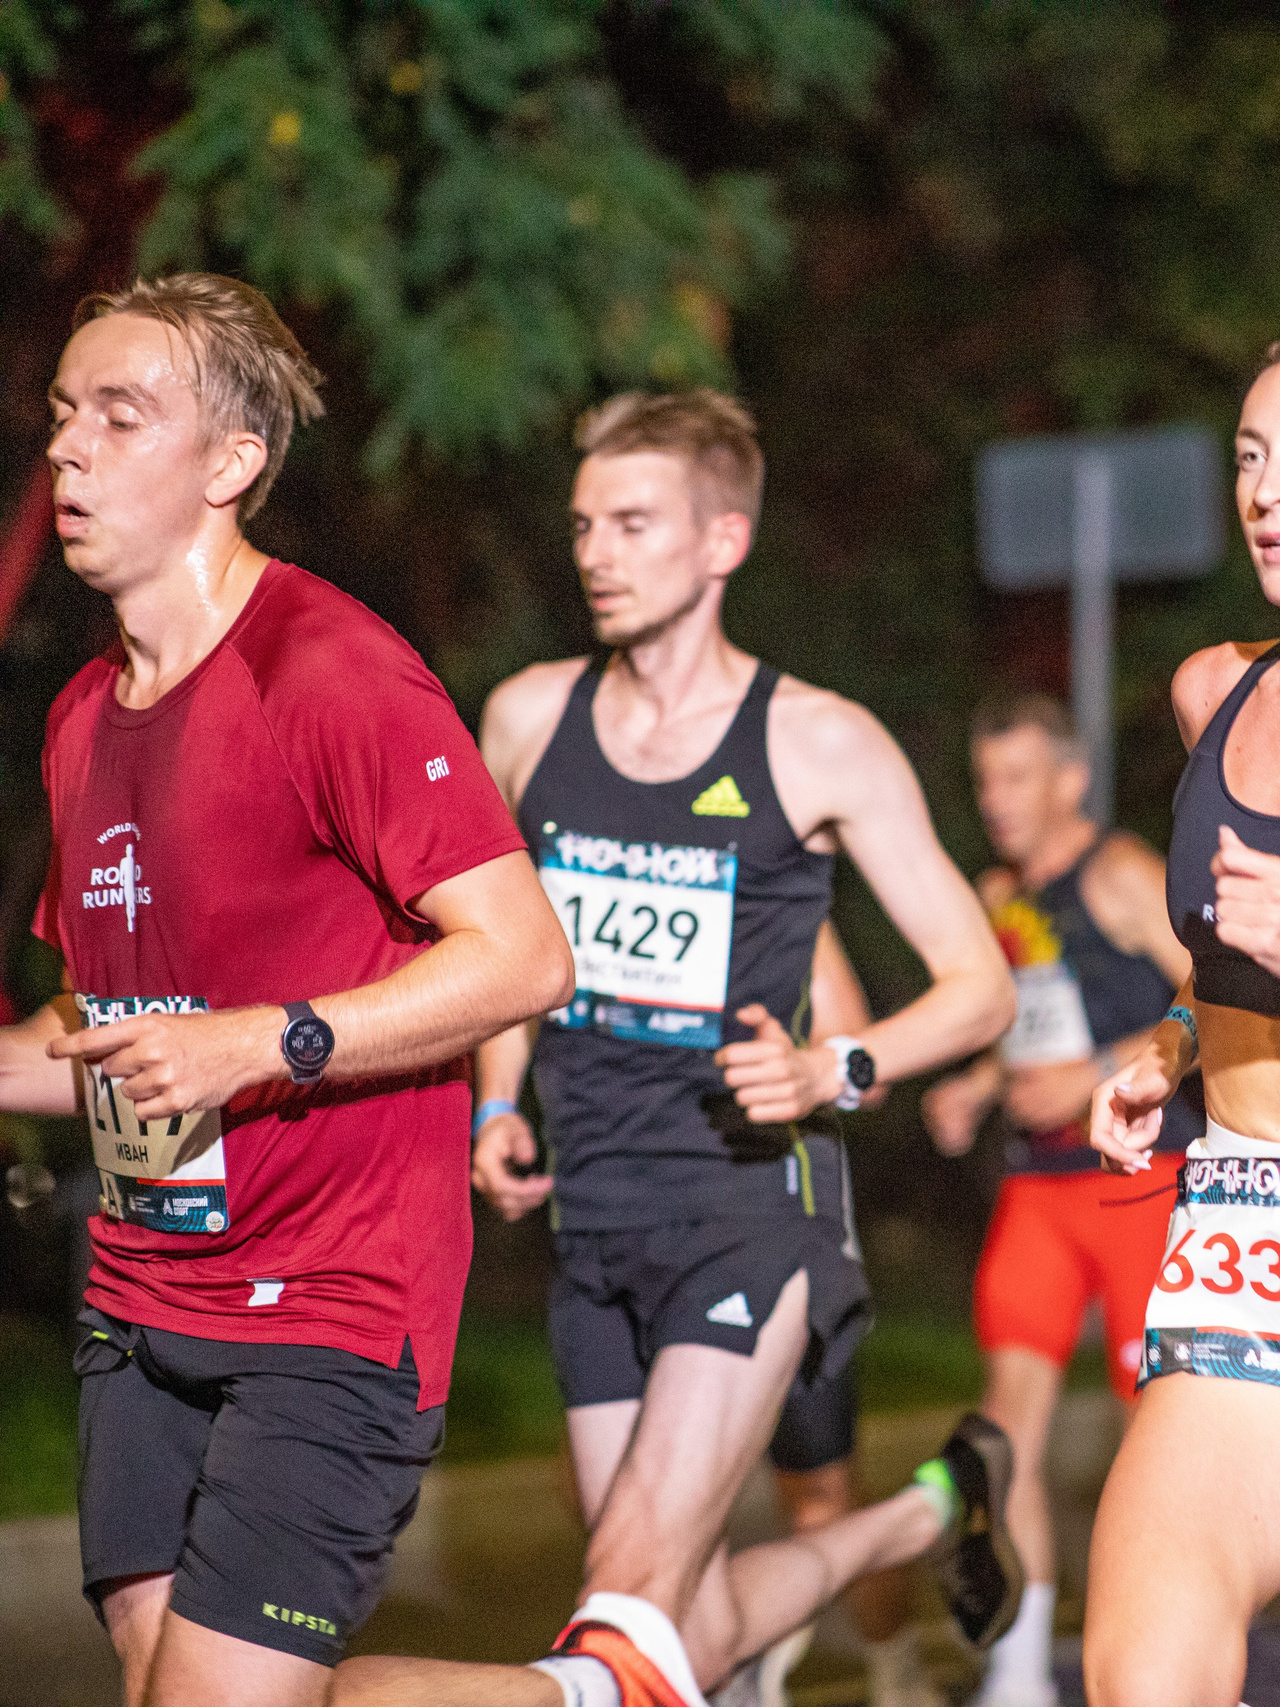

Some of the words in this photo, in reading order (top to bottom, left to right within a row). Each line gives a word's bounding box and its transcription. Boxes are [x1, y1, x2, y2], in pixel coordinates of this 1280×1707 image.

[426, 755, 450, 782] GRi
[97, 822, 131, 845] WORLD
[564, 894, 700, 962] 1429
[115, 1142, 149, 1164] ИВАН
[261, 1602, 337, 1637] KIPSTA
